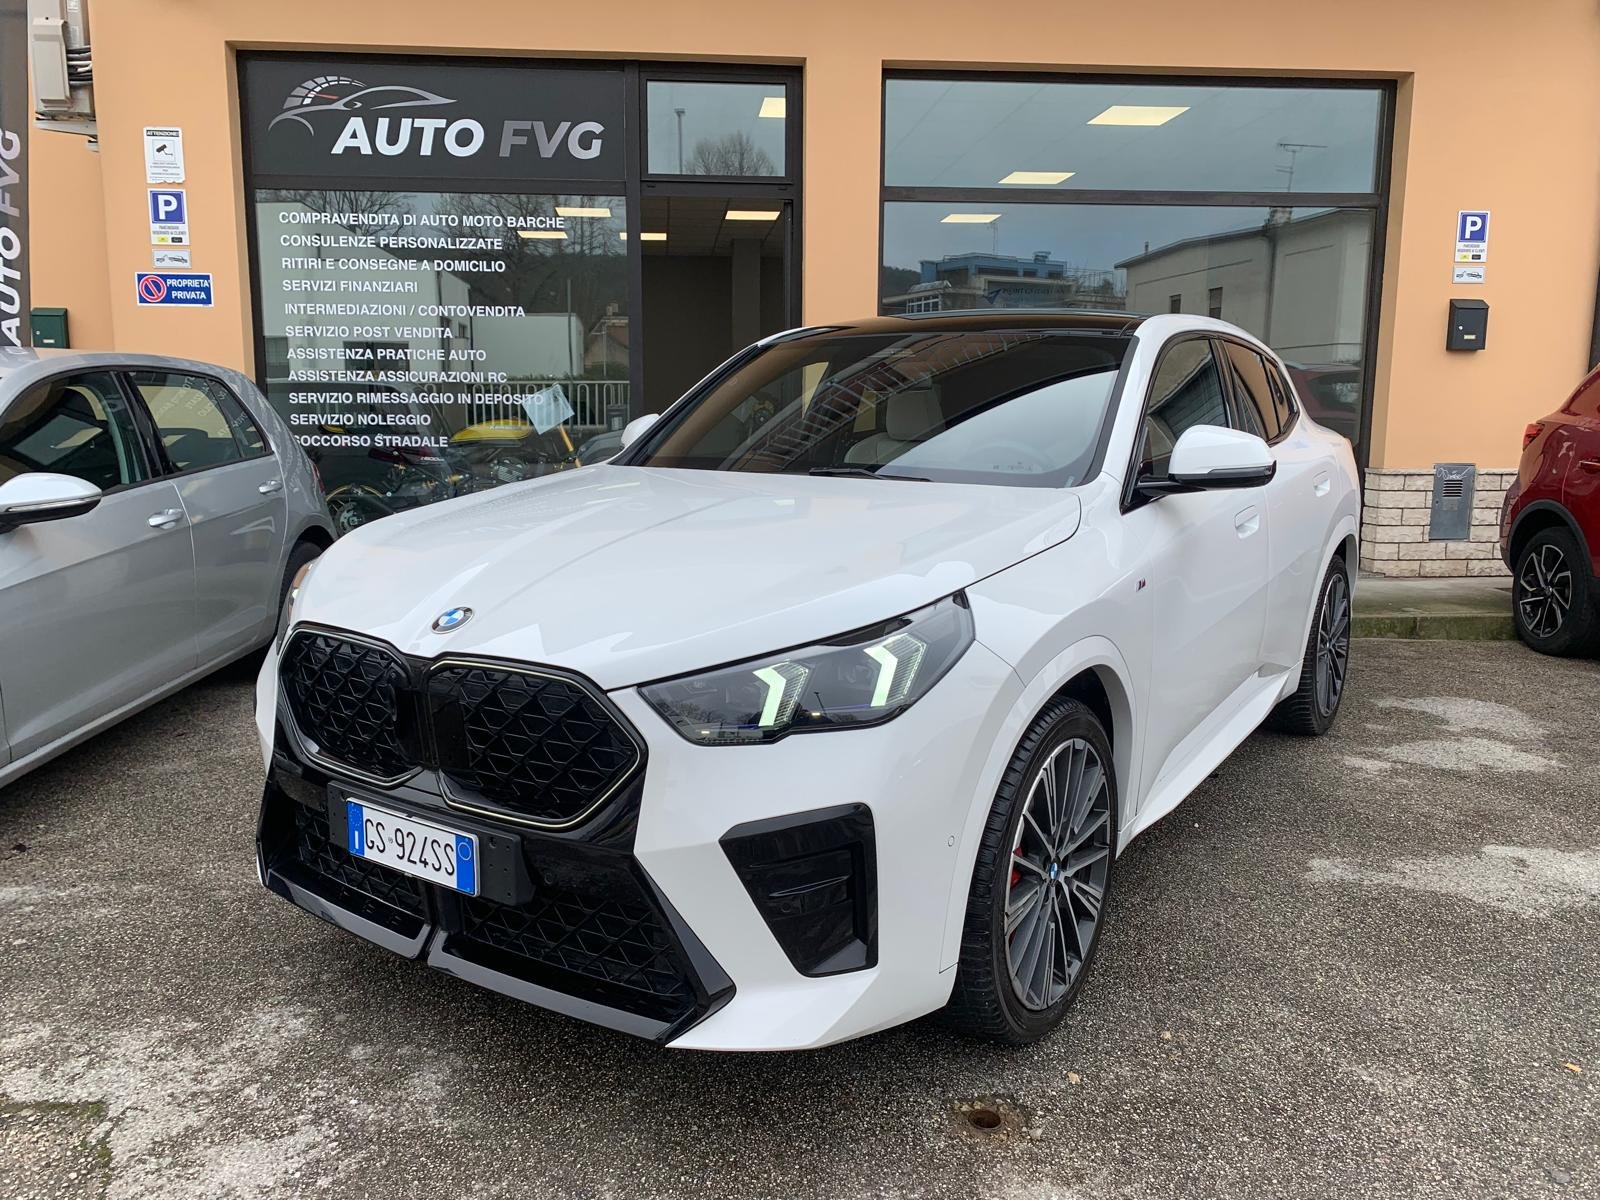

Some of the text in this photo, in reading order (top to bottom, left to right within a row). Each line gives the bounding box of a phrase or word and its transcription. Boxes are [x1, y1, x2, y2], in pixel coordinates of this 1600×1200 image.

[331, 117, 605, 160] AUTO FVG
[158, 195, 178, 219] P
[278, 212, 565, 228] COMPRAVENDITA DI AUTO MOTO BARCHE
[1465, 216, 1482, 239] P
[0, 130, 21, 349] AUTO FVG
[280, 235, 503, 250] CONSULENZE PERSONALIZZATE
[282, 258, 506, 273] RITIRI E CONSEGNE A DOMICILIO
[282, 280, 418, 292] SERVIZI FINANZIARI
[171, 291, 207, 300] PRIVATA
[285, 304, 526, 317] INTERMEDIAZIONI / CONTOVENDITA
[285, 325, 453, 338] SERVIZIO POST VENDITA
[287, 347, 487, 360] ASSISTENZA PRATICHE AUTO
[288, 370, 508, 384] ASSISTENZA ASSICURAZIONI RC
[289, 391, 544, 406] SERVIZIO RIMESSAGGIO IN DEPOSITO
[290, 412, 432, 427] SERVIZIO NOLEGGIO
[374, 434, 449, 447] STRADALE
